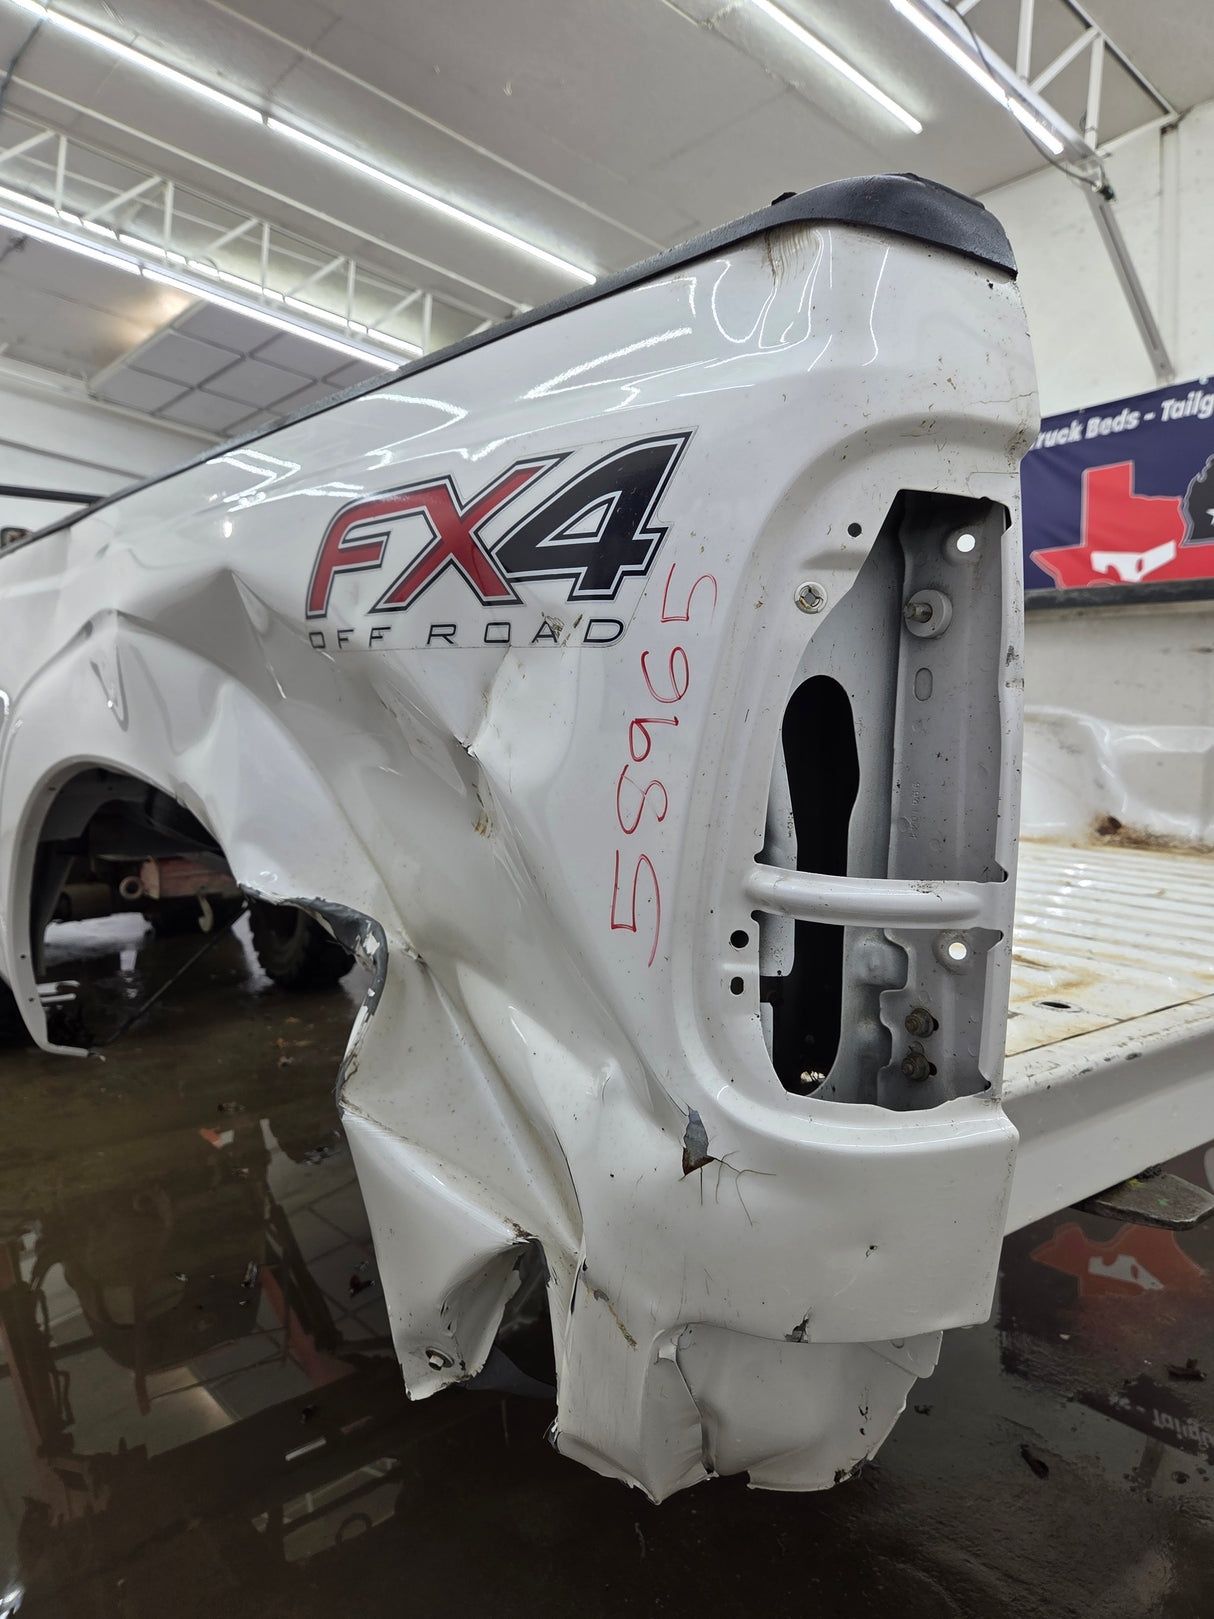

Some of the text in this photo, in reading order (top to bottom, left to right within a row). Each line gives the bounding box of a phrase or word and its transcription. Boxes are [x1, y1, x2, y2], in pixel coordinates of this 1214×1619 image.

[1030, 419, 1084, 450] ruck
[1084, 407, 1141, 440] Beds
[1143, 411, 1156, 421] -
[306, 431, 693, 619] FX4
[308, 618, 625, 649] OFF ROAD
[611, 563, 718, 968] 58965
